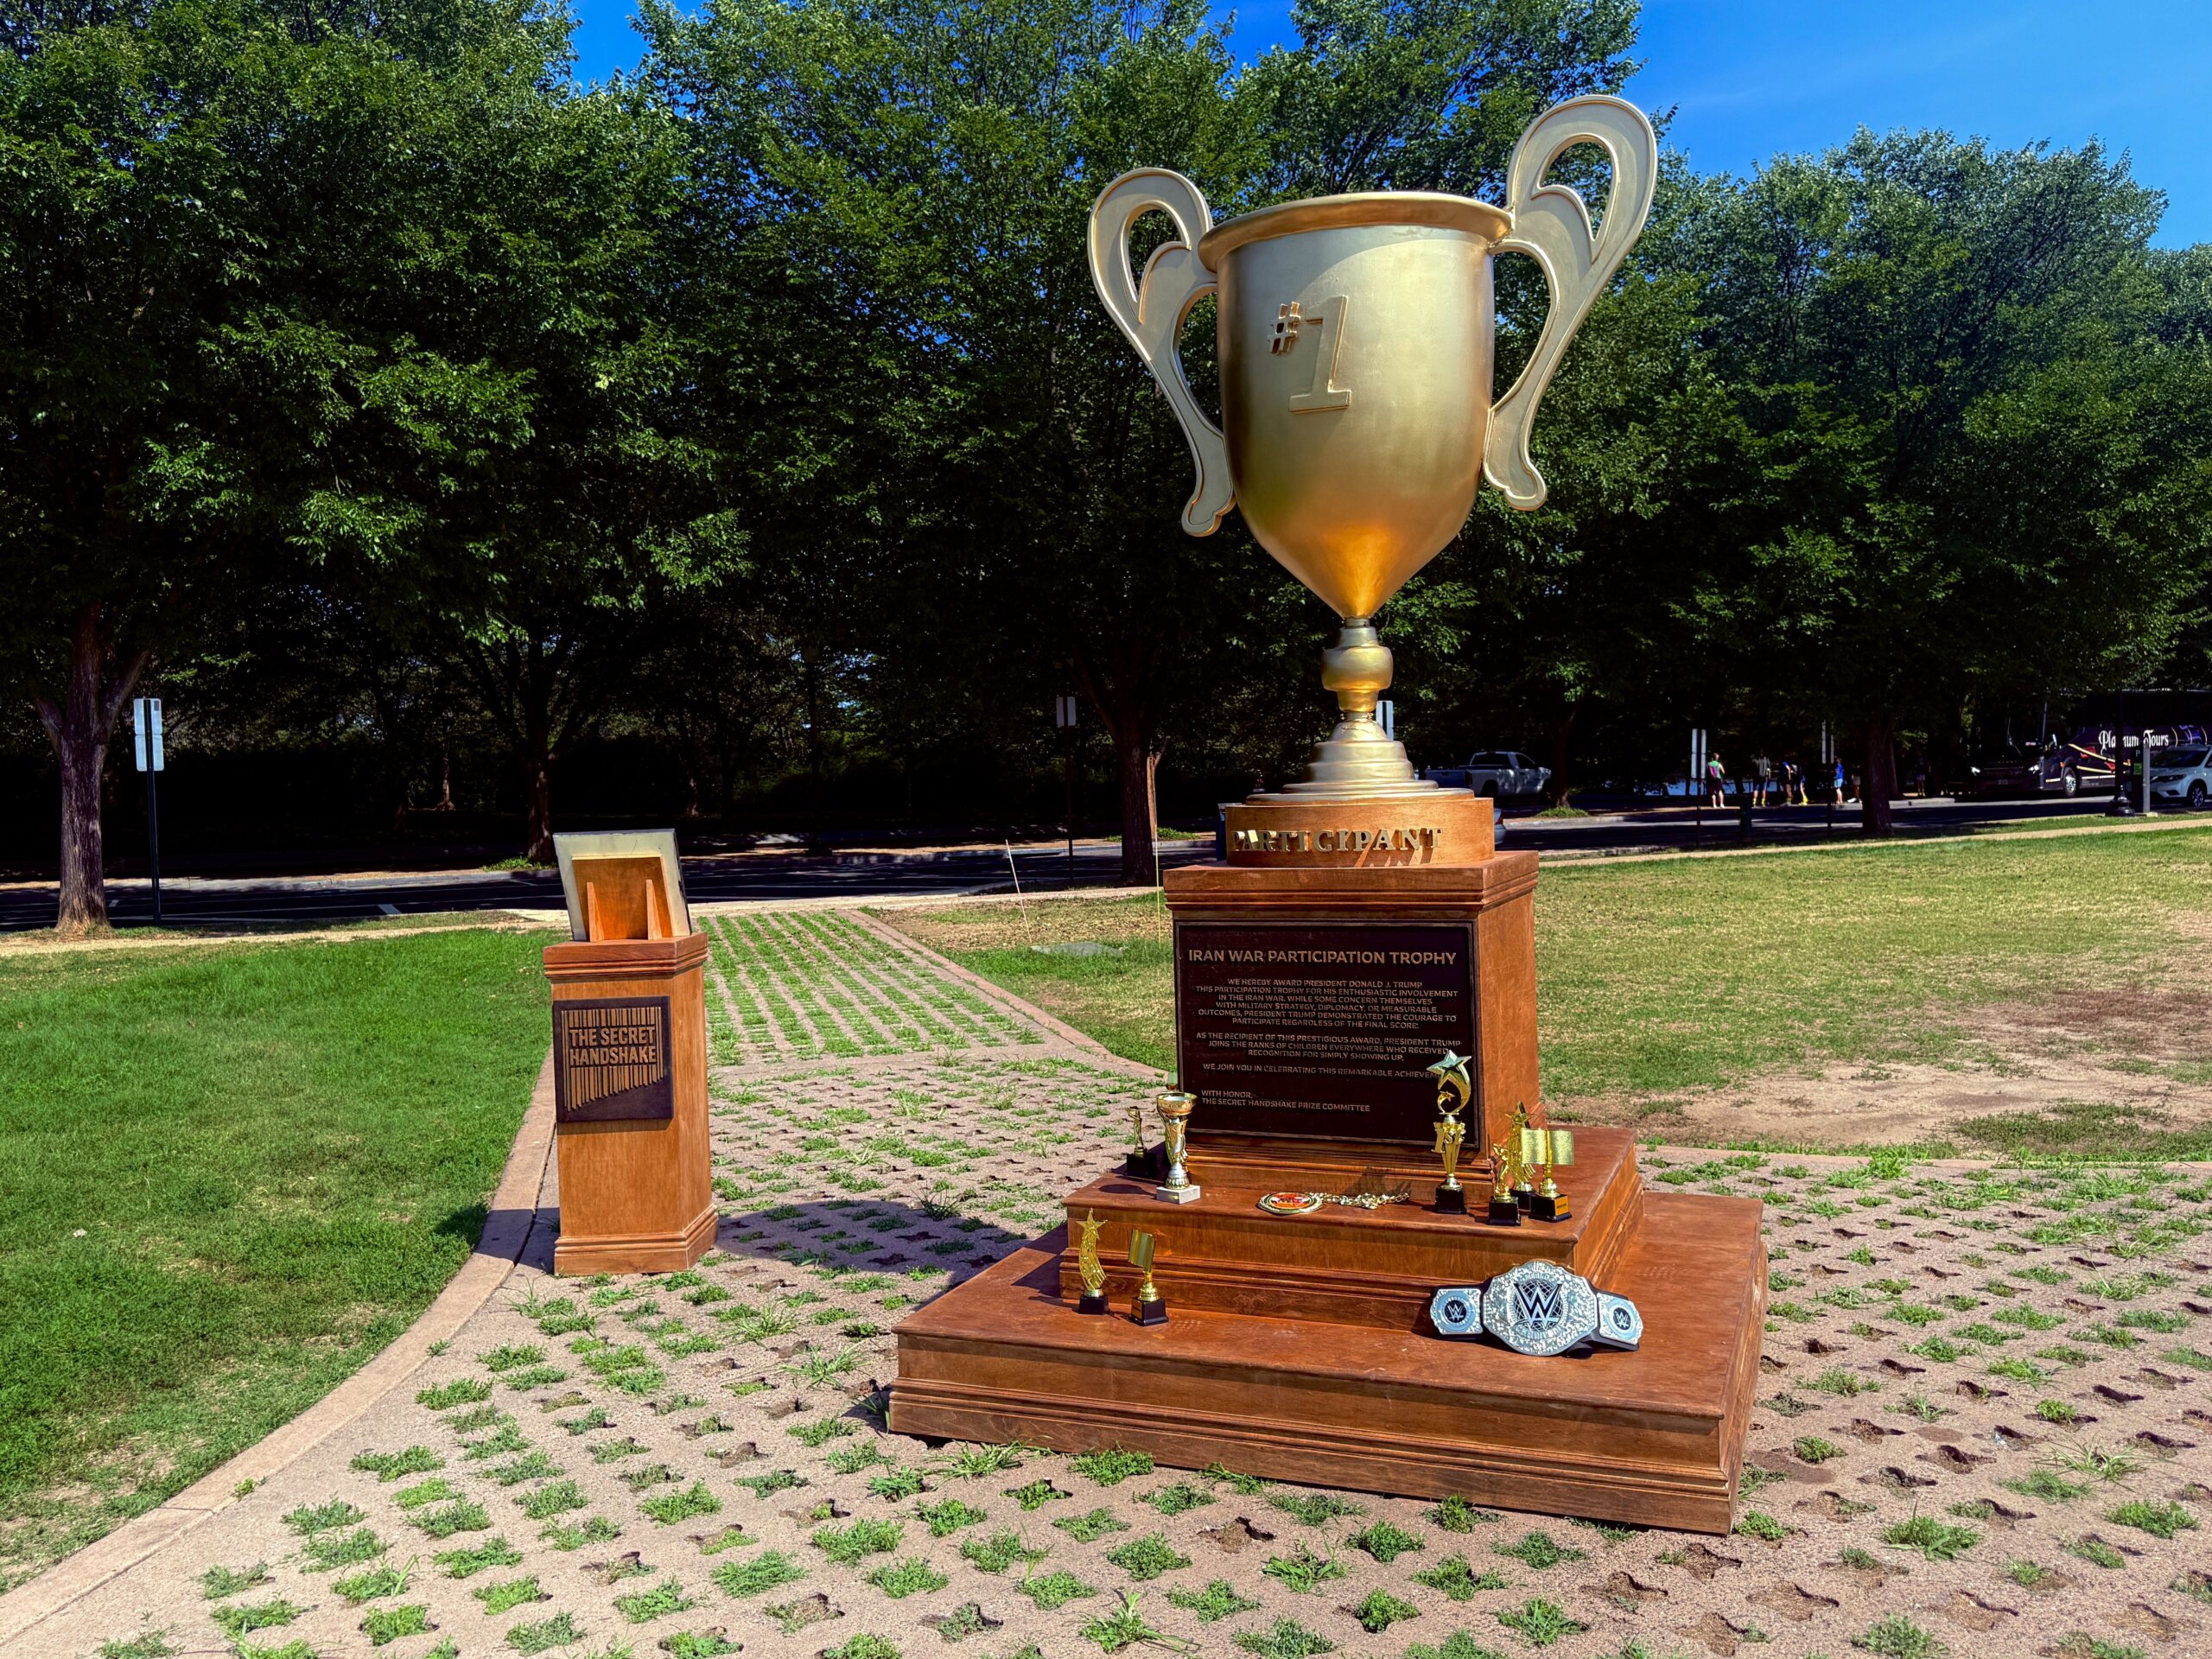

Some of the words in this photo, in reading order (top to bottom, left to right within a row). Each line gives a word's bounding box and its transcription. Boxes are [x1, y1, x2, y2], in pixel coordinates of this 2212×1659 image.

[1267, 295, 1352, 415] #1
[2098, 730, 2139, 755] Planum
[2143, 729, 2169, 748] Tours
[1230, 828, 1444, 852] PARTICIPANT
[1189, 950, 1224, 962] IRAN
[1228, 950, 1264, 963] WAR
[1268, 950, 1385, 964] PARTICIPATION
[1389, 951, 1457, 965] TROPHY
[1198, 1008, 1243, 1017] OUTCOMES,
[569, 1028, 598, 1046] THE
[600, 1027, 656, 1046] SECRET
[569, 1046, 657, 1065] HANDSHAKE
[1263, 1065, 1317, 1074] CELEBRATING
[1338, 1068, 1393, 1077] REMARKABLE
[1223, 1090, 1254, 1099] HONOR,
[1248, 1100, 1297, 1109] HANDSHAKE
[1322, 1103, 1370, 1112] COMMITTEE
